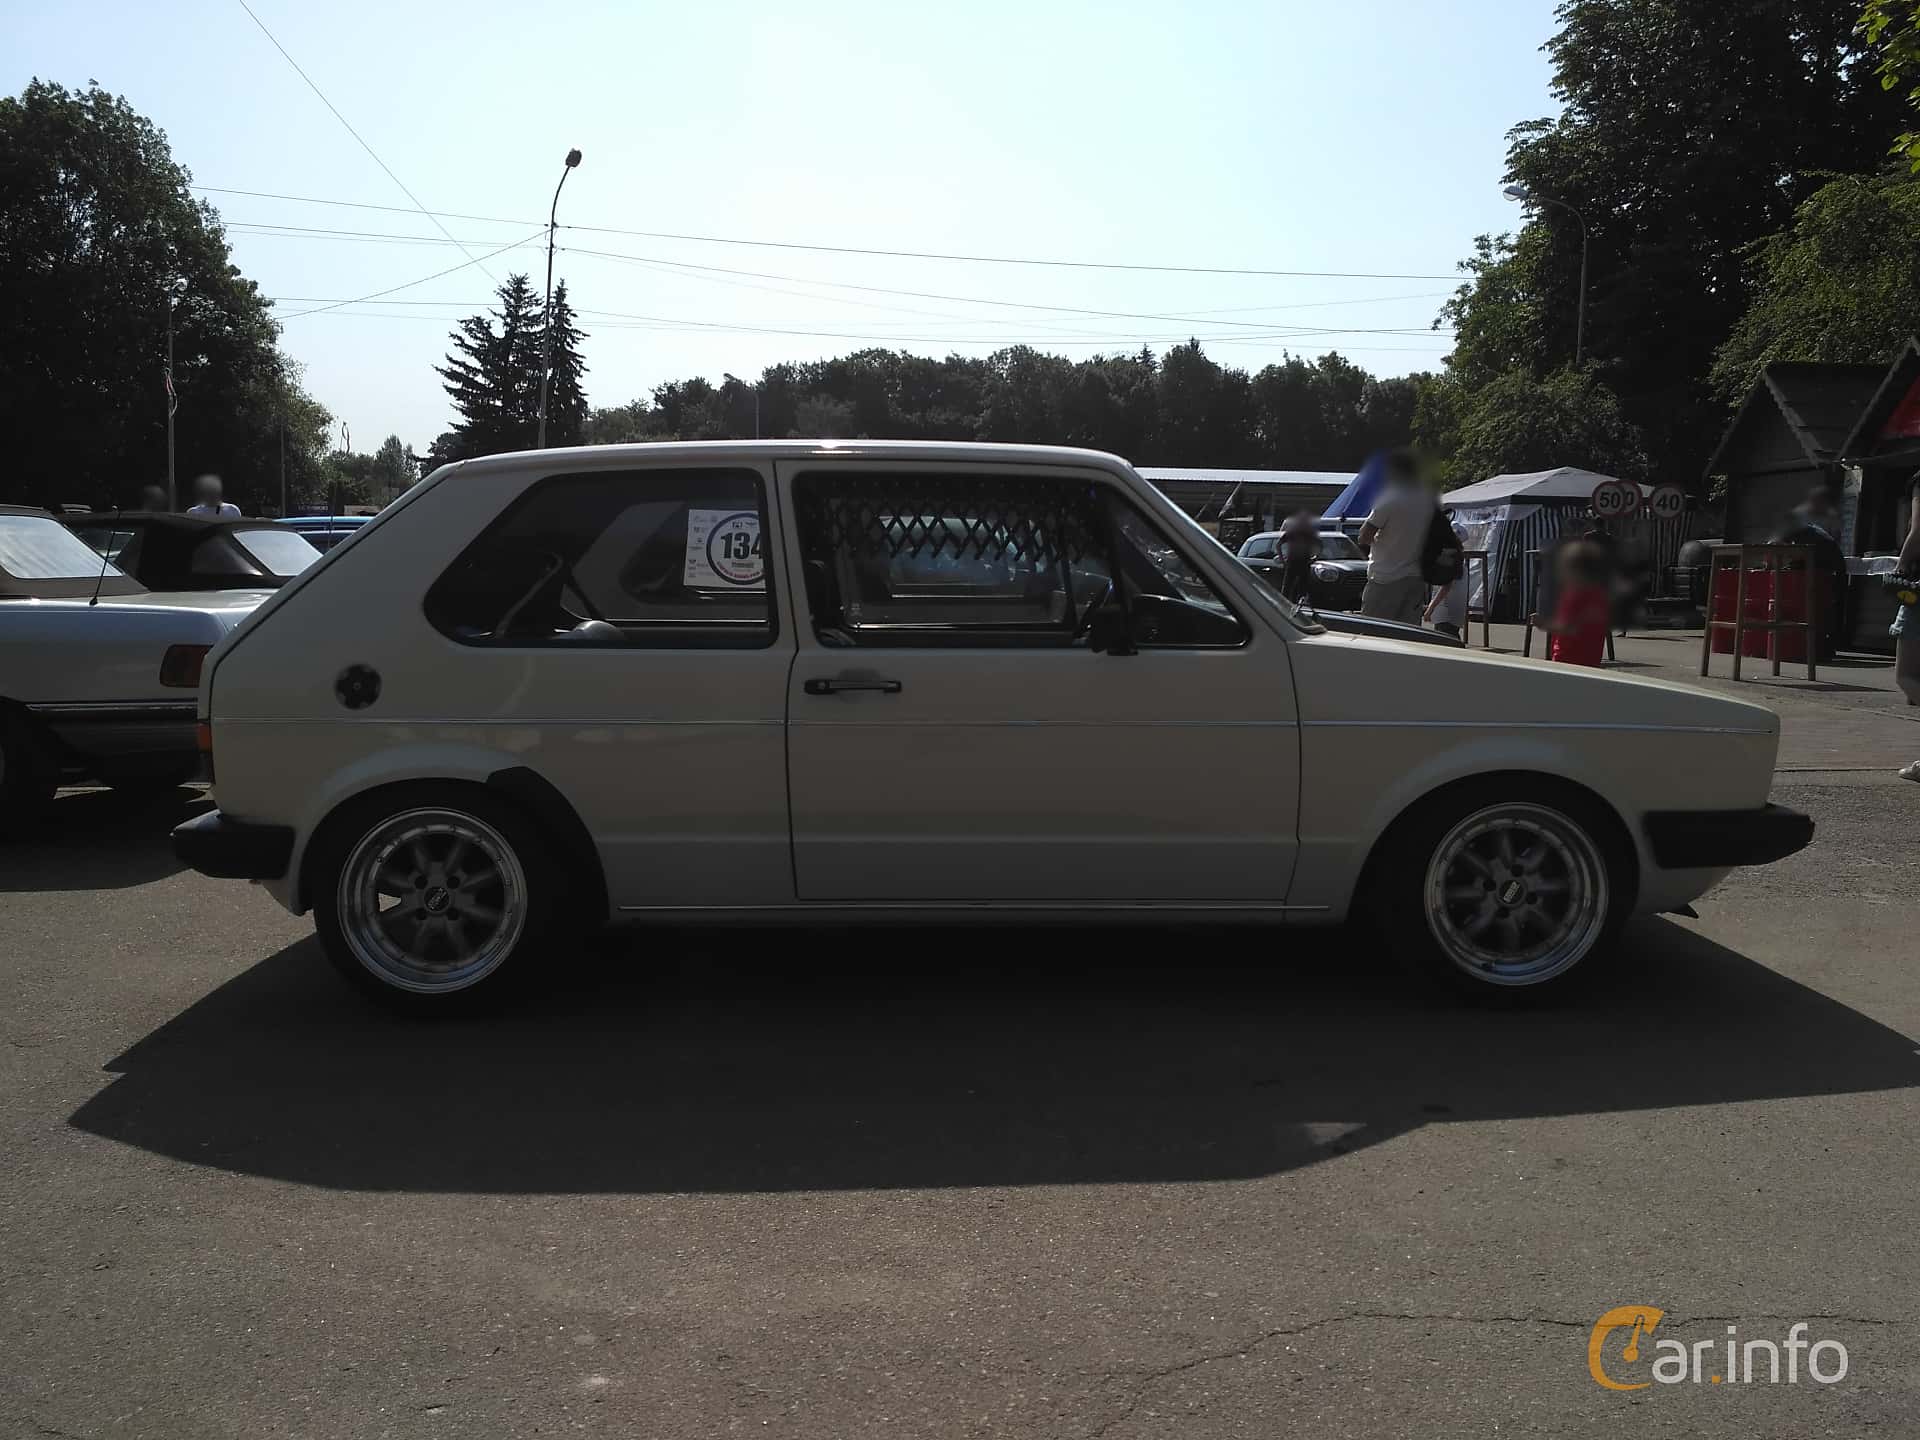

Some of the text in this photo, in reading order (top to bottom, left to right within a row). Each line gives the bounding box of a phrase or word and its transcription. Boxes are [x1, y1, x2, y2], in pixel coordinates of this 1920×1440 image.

[1599, 491, 1621, 509] 50
[1656, 493, 1680, 511] 40
[720, 531, 762, 560] 134
